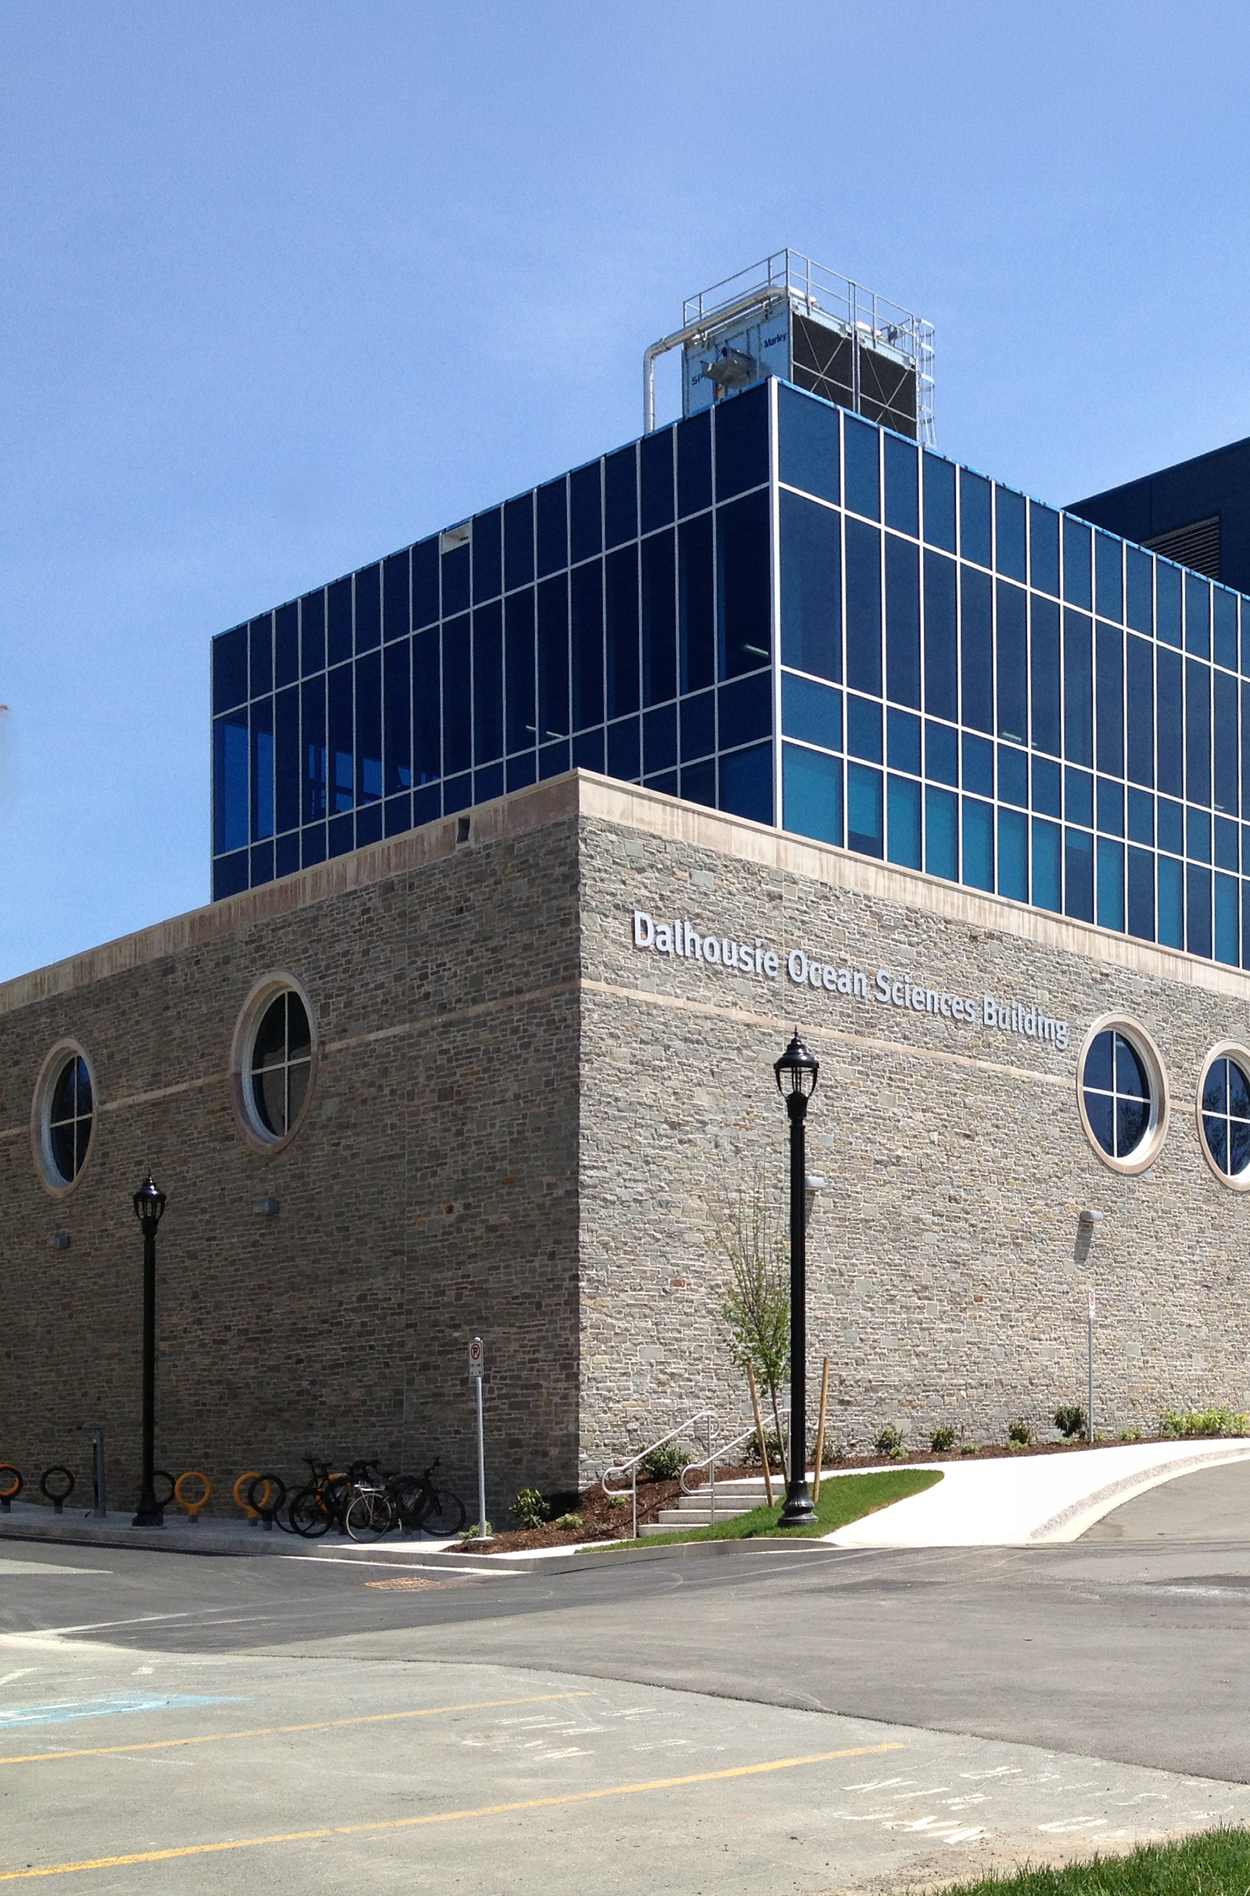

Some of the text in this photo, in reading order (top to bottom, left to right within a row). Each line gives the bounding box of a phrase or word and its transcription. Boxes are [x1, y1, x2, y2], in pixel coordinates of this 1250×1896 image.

[764, 331, 787, 349] Marley
[691, 373, 708, 386] SP
[633, 910, 1069, 1050] Dalhousie Ocean Sciences Building
